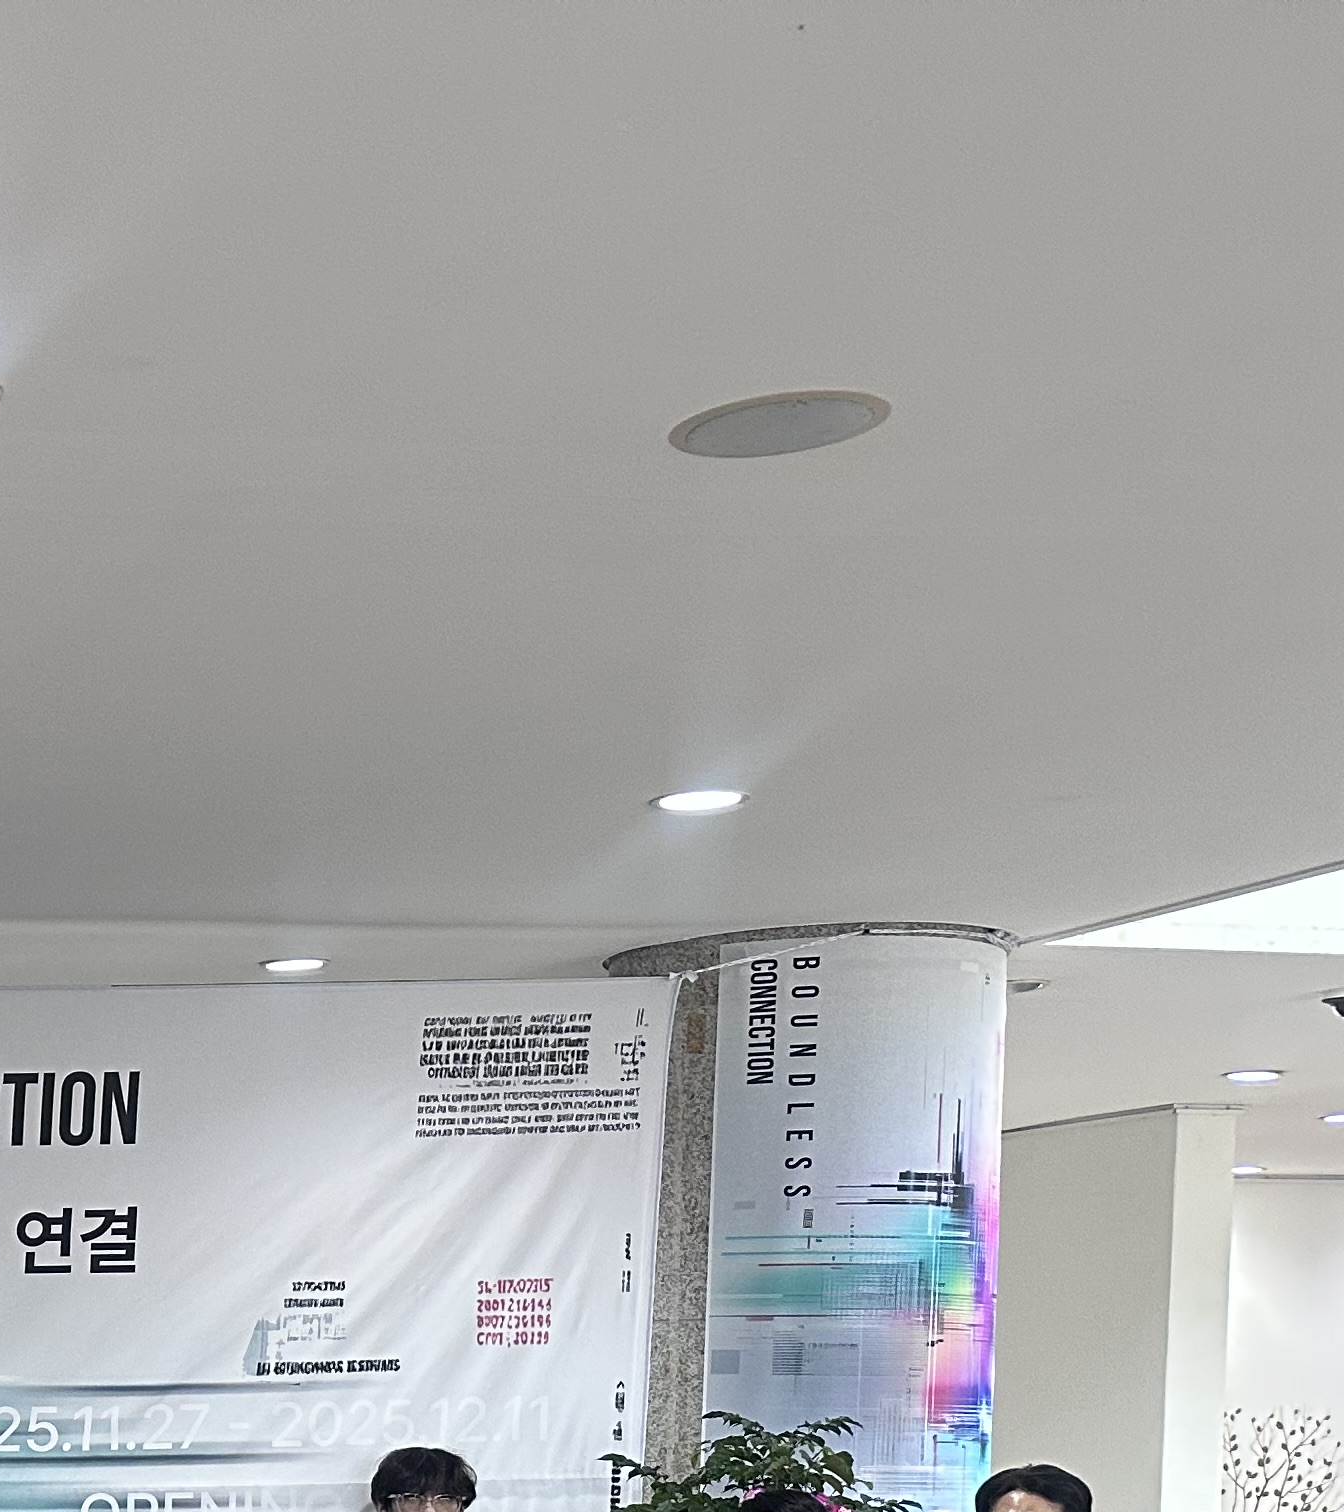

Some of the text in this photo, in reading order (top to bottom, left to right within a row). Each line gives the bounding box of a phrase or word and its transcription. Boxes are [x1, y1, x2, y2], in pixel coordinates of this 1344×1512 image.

[746, 958, 778, 1085] CONNECTION
[783, 956, 821, 1197] BOUNDLESS
[16, 1206, 138, 1274] 연결
[271, 1395, 551, 1449] 2025.12.11
